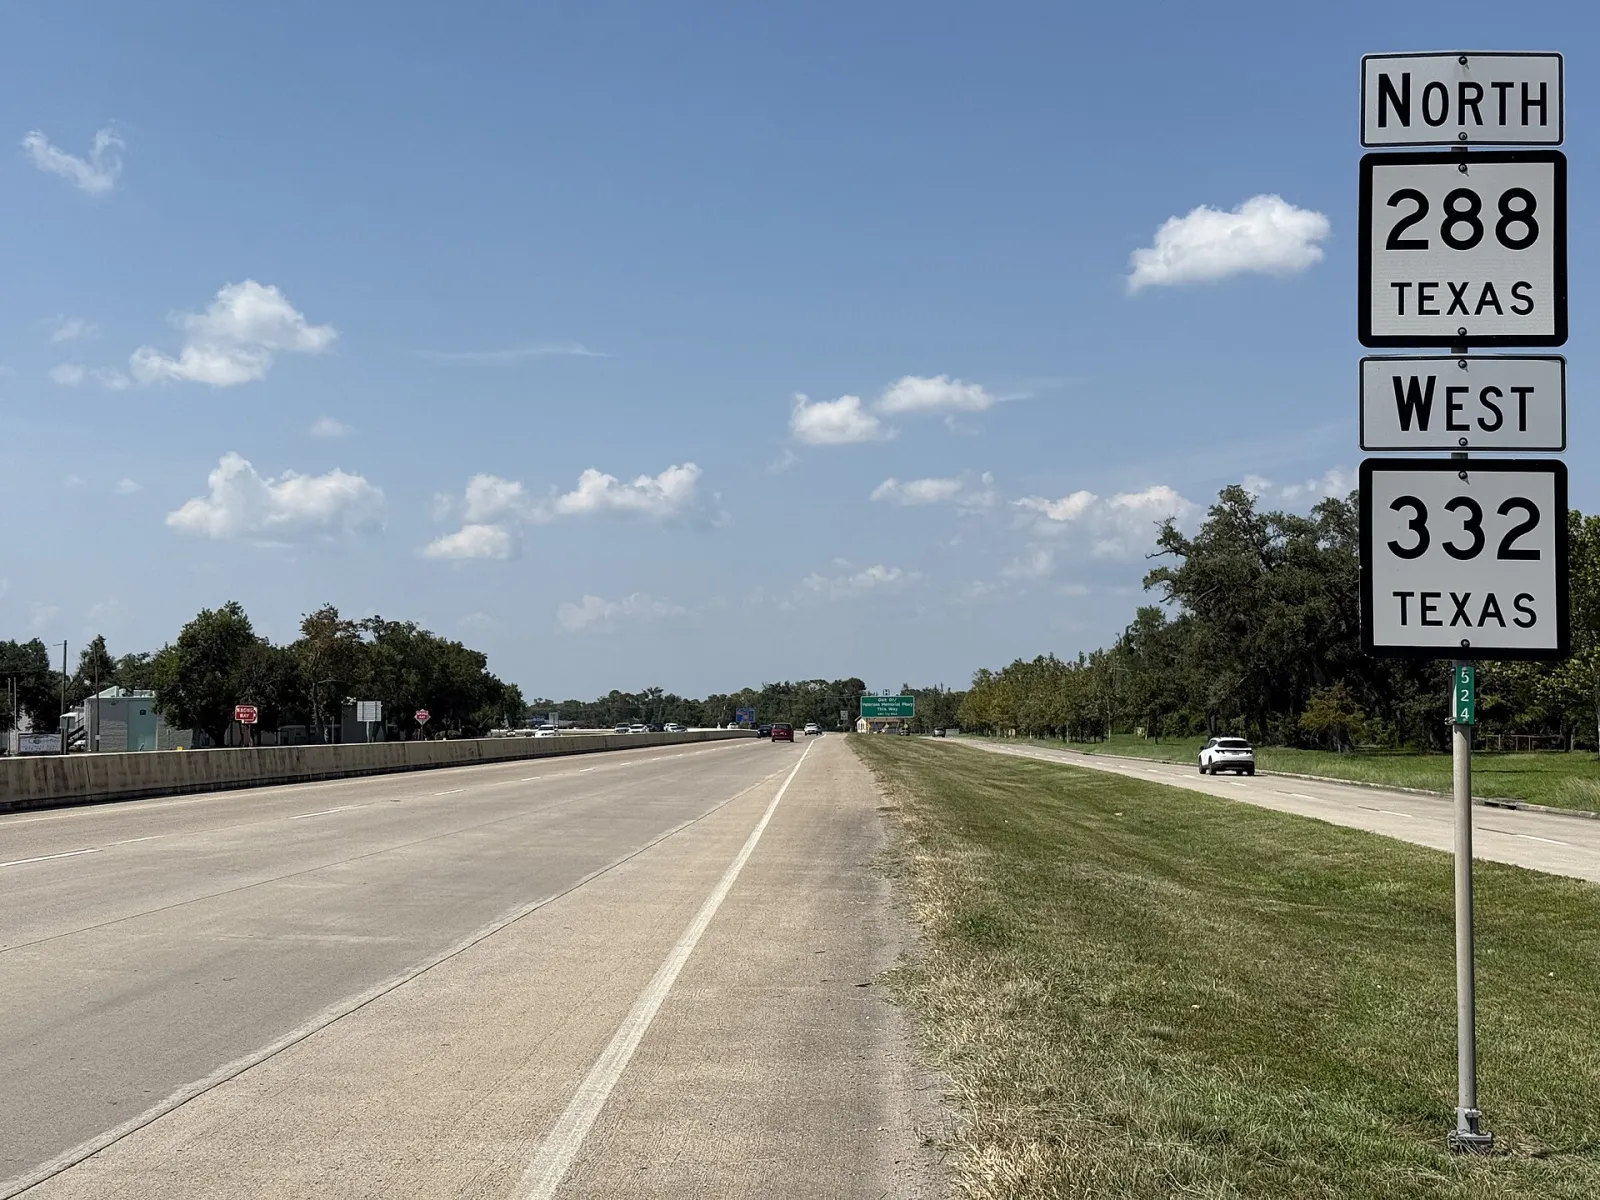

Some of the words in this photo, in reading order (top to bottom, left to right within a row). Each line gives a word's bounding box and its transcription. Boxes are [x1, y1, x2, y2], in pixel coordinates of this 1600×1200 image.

[1377, 72, 1548, 128] NORTH
[1385, 187, 1540, 251] 288
[1390, 280, 1535, 316] TEXAS
[1393, 375, 1535, 433] WEST
[1387, 495, 1541, 561] 332
[1392, 591, 1537, 629] TEXAS
[1460, 671, 1470, 720] 524
